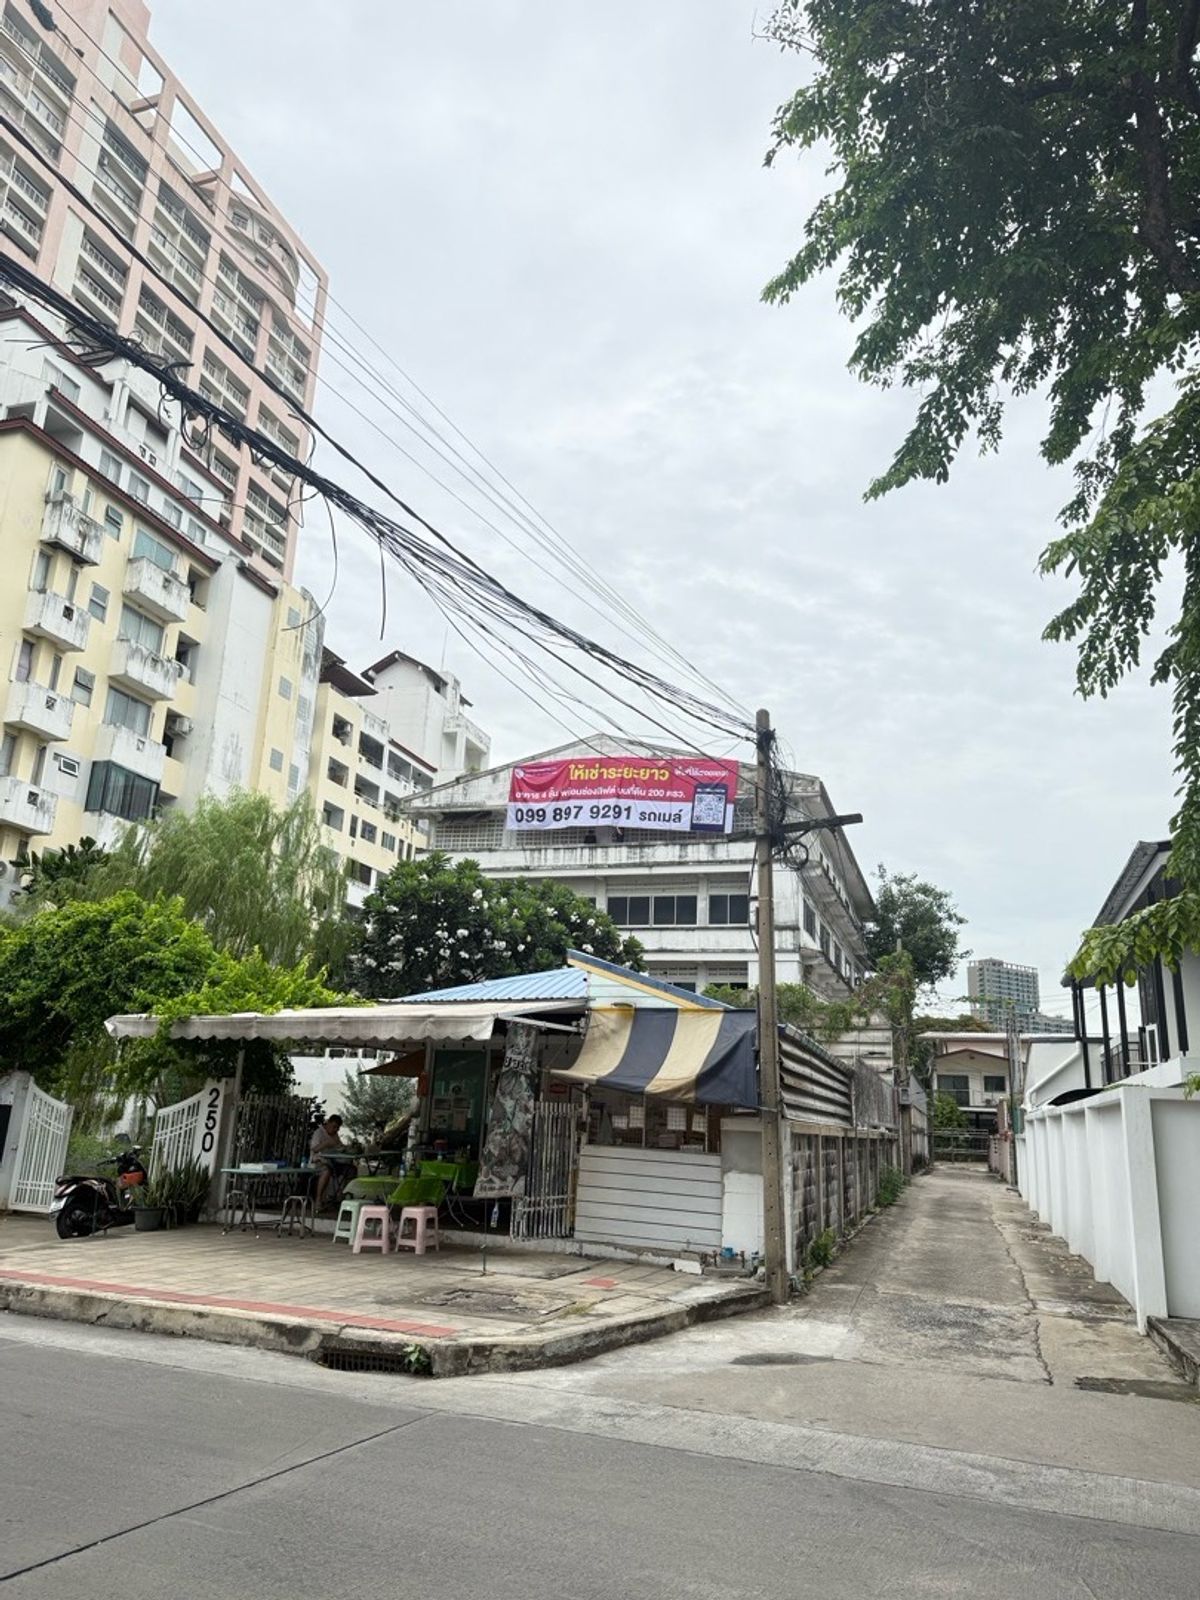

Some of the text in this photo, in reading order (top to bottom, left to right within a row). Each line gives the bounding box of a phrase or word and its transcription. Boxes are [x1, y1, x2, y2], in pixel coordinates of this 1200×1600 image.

[568, 762, 669, 781] ให้เช่าระยะยาว
[647, 789, 665, 797] 200
[515, 804, 683, 823] 099 897 9291 รถเมล์
[202, 1087, 220, 1153] 250
